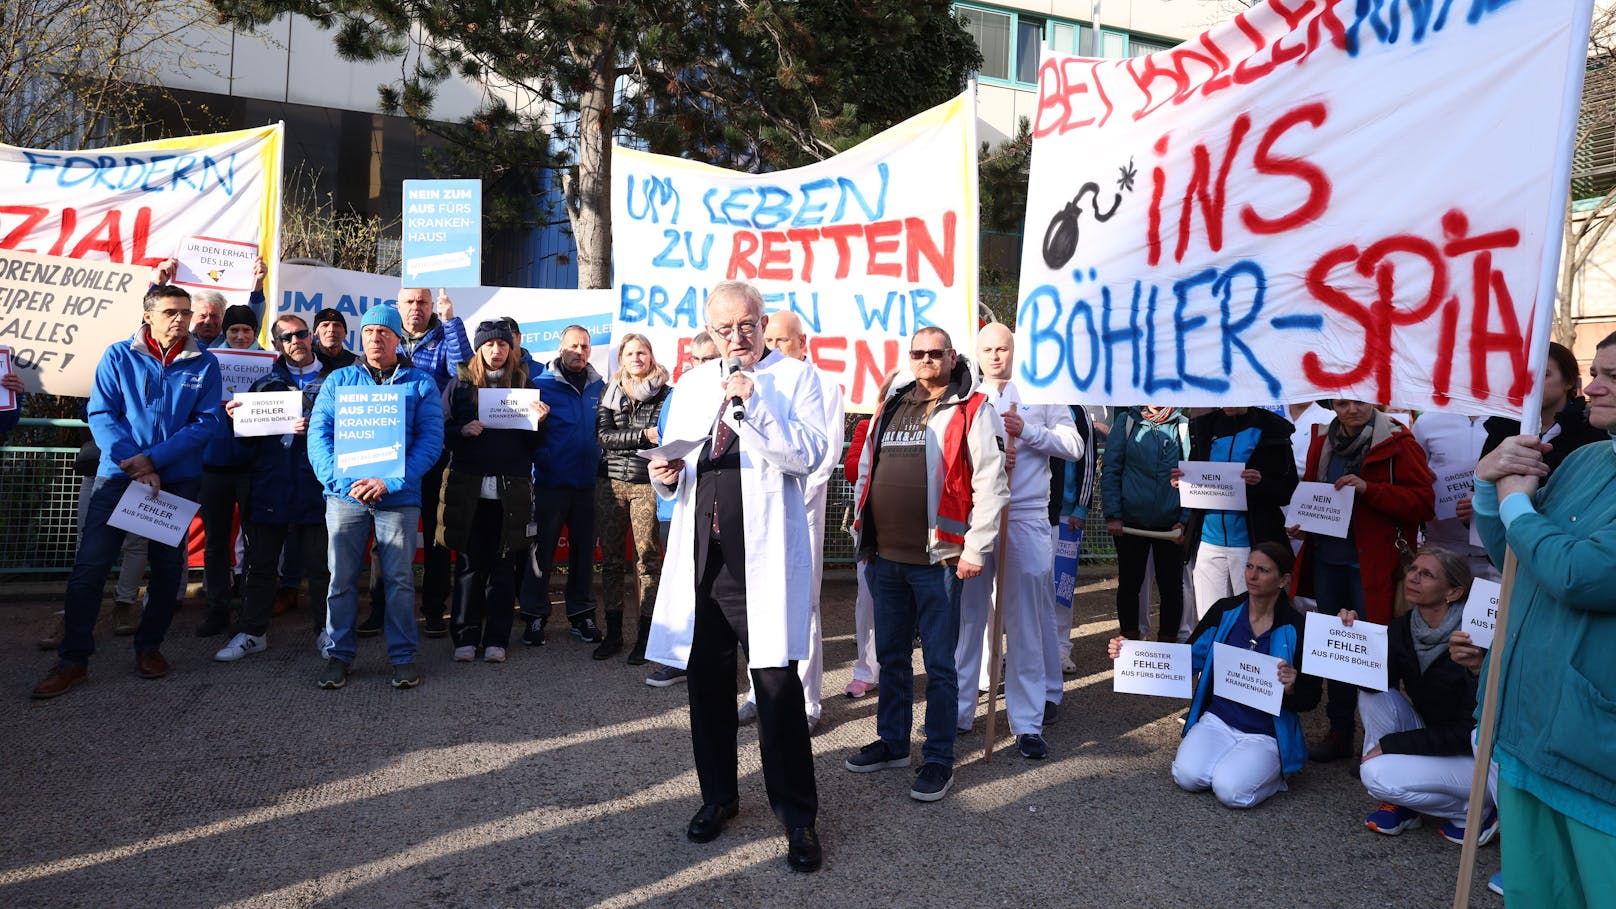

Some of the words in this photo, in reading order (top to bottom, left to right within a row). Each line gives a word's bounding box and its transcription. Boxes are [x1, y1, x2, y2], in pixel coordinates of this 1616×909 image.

[22, 151, 236, 196] FORDERN
[408, 189, 440, 200] NEIN
[443, 189, 472, 199] ZUM
[627, 174, 680, 225] UM
[703, 162, 889, 229] LEBEN
[408, 203, 435, 214] AUS
[438, 202, 471, 214] FÜRS
[408, 217, 475, 228] KRANKEN-
[0, 205, 172, 268] ZIAL
[408, 232, 447, 242] HAUS!
[202, 246, 220, 255] DEN
[222, 248, 254, 260] ERHALT
[652, 229, 714, 270] ZU
[726, 210, 957, 288] RETTEN
[200, 256, 217, 266] DES
[219, 260, 235, 268] LBK
[62, 295, 113, 318] HOF
[278, 290, 322, 316] UM
[854, 288, 938, 336] WIR
[0, 318, 78, 345] ALLES
[520, 332, 541, 344] TET
[543, 330, 563, 341] DA
[219, 363, 231, 371] BK
[233, 363, 270, 374] GEHÖRT
[339, 394, 368, 402] NEIN
[371, 393, 398, 402] ZUM
[339, 406, 364, 415] AUS
[367, 403, 398, 414] FÜRS
[338, 417, 401, 427] KRANKEN-
[338, 430, 375, 439] HAUS!
[1447, 480, 1474, 492] FEHL
[1313, 495, 1332, 504] NEIN
[1439, 495, 1453, 504] AUS
[122, 508, 135, 516] AUS
[1470, 618, 1488, 629] AUS
[1311, 649, 1328, 658] AUS
[1329, 652, 1350, 663] FÜRS
[1240, 662, 1260, 674] NEIN
[1227, 670, 1240, 678] ZUM
[1241, 674, 1254, 682] AUS
[1256, 678, 1272, 688] FÜRS
